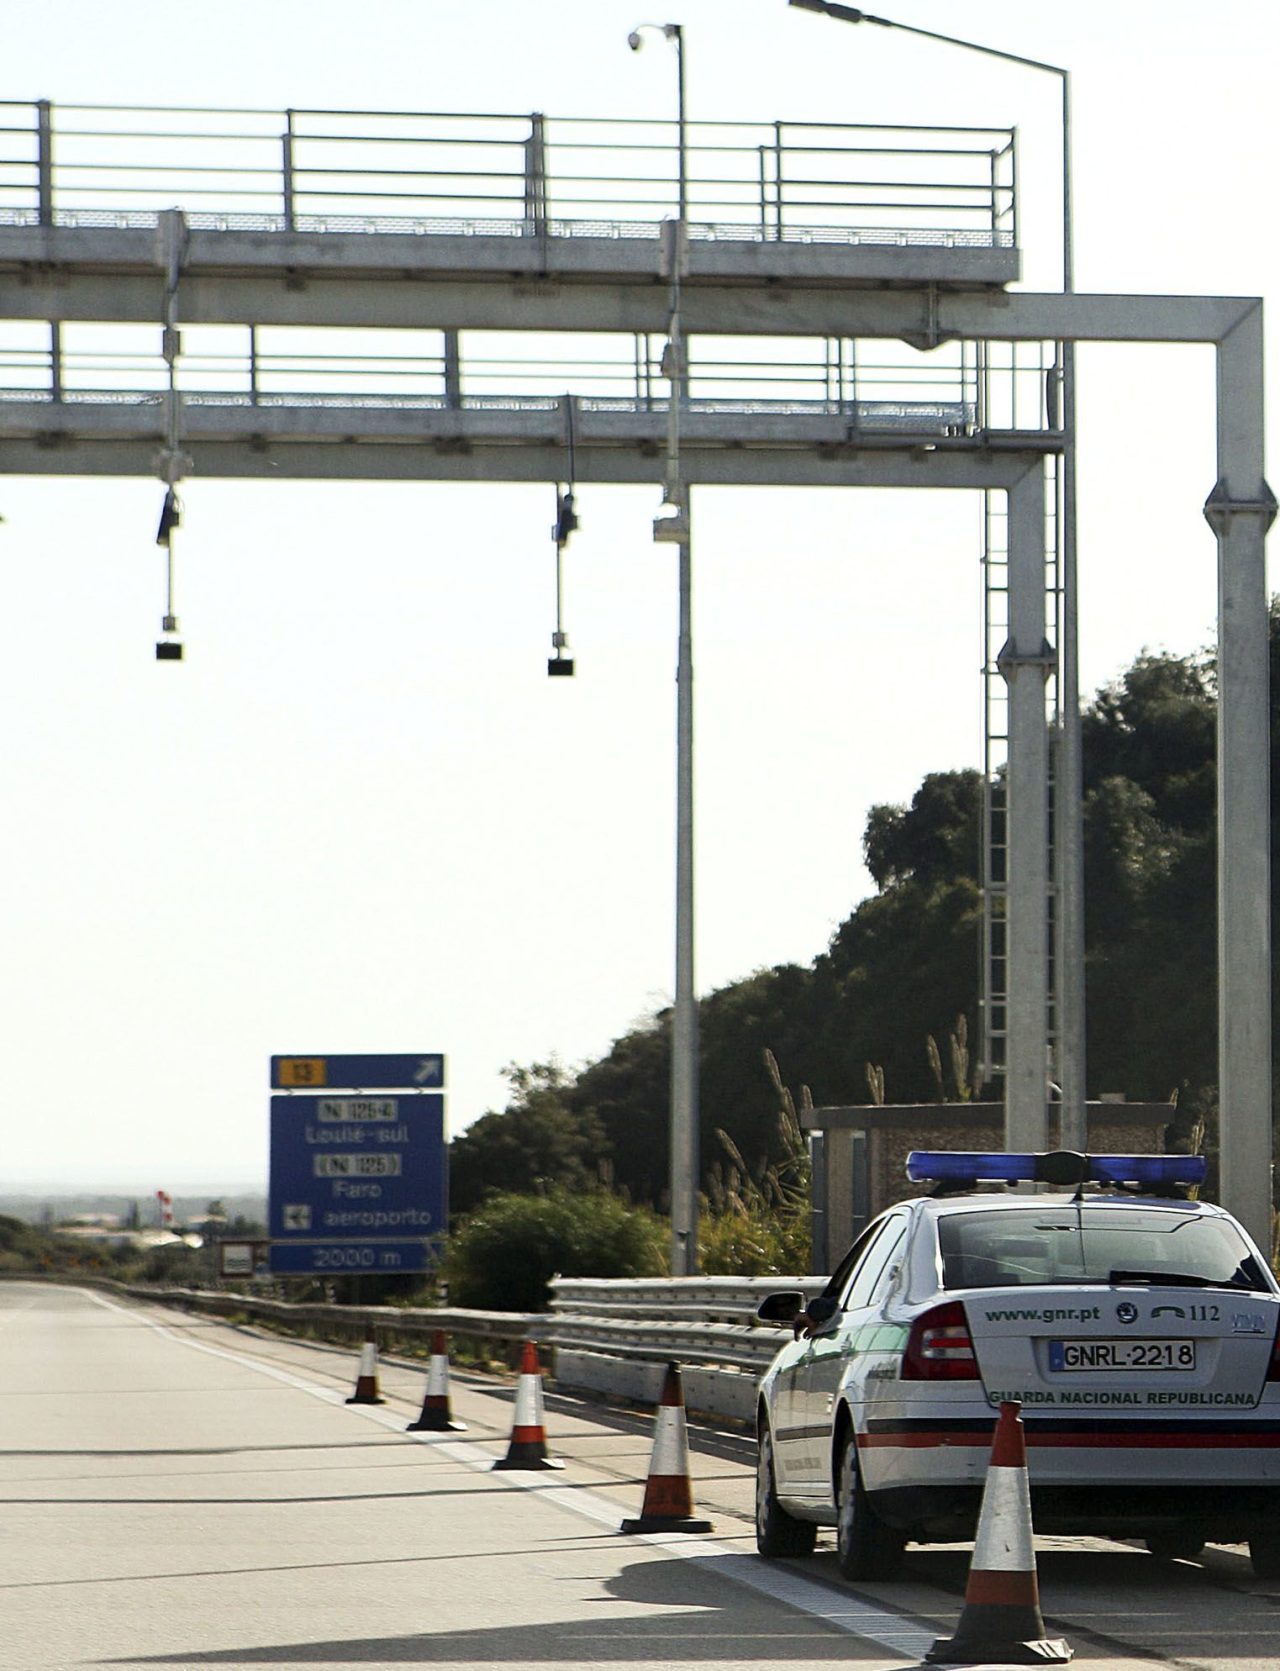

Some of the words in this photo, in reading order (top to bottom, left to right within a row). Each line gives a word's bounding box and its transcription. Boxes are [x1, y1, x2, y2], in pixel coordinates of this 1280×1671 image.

[332, 1180, 382, 1198] Faro
[325, 1208, 432, 1228] aeroporto
[314, 1249, 375, 1267] 2000
[383, 1252, 401, 1266] m
[985, 1305, 1100, 1323] www.gnr.pt
[1189, 1305, 1220, 1321] 112
[989, 1391, 1055, 1404] GUARDA
[1060, 1391, 1142, 1405] NACIONAL
[1147, 1391, 1255, 1406] REPUBLICANA
